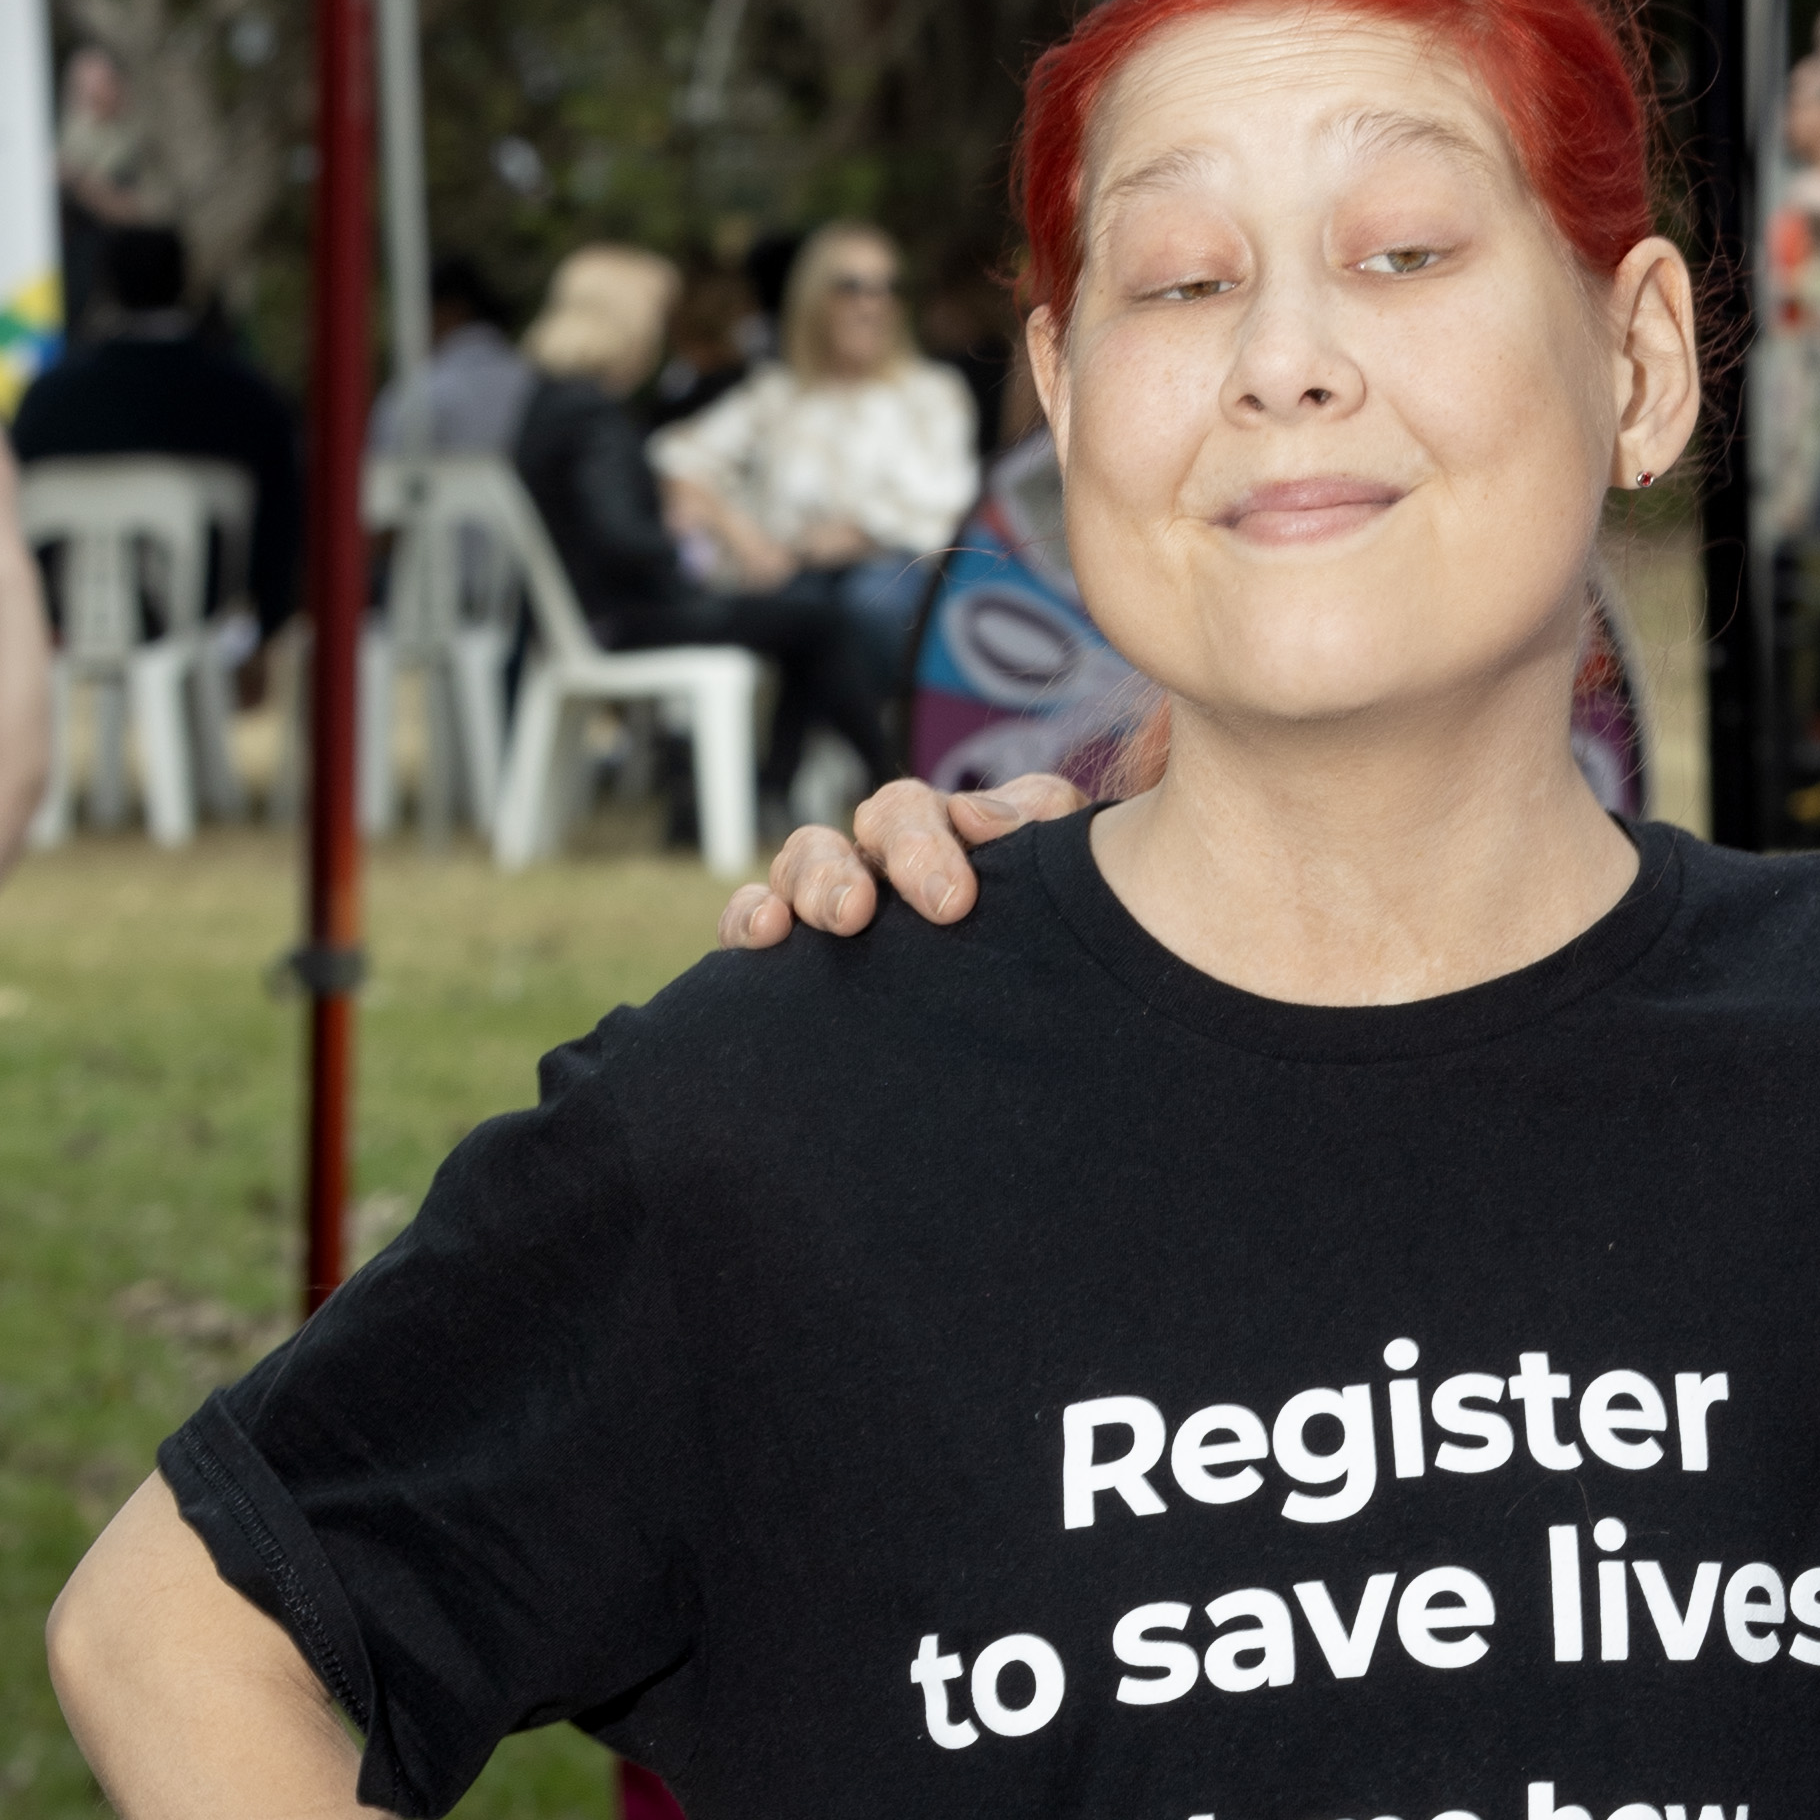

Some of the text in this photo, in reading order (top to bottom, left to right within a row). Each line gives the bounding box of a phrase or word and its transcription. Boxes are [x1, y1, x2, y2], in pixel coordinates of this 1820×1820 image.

[1061, 1336, 1731, 1530] Register
[908, 1632, 1067, 1751] to
[1111, 1564, 1497, 1707] save
